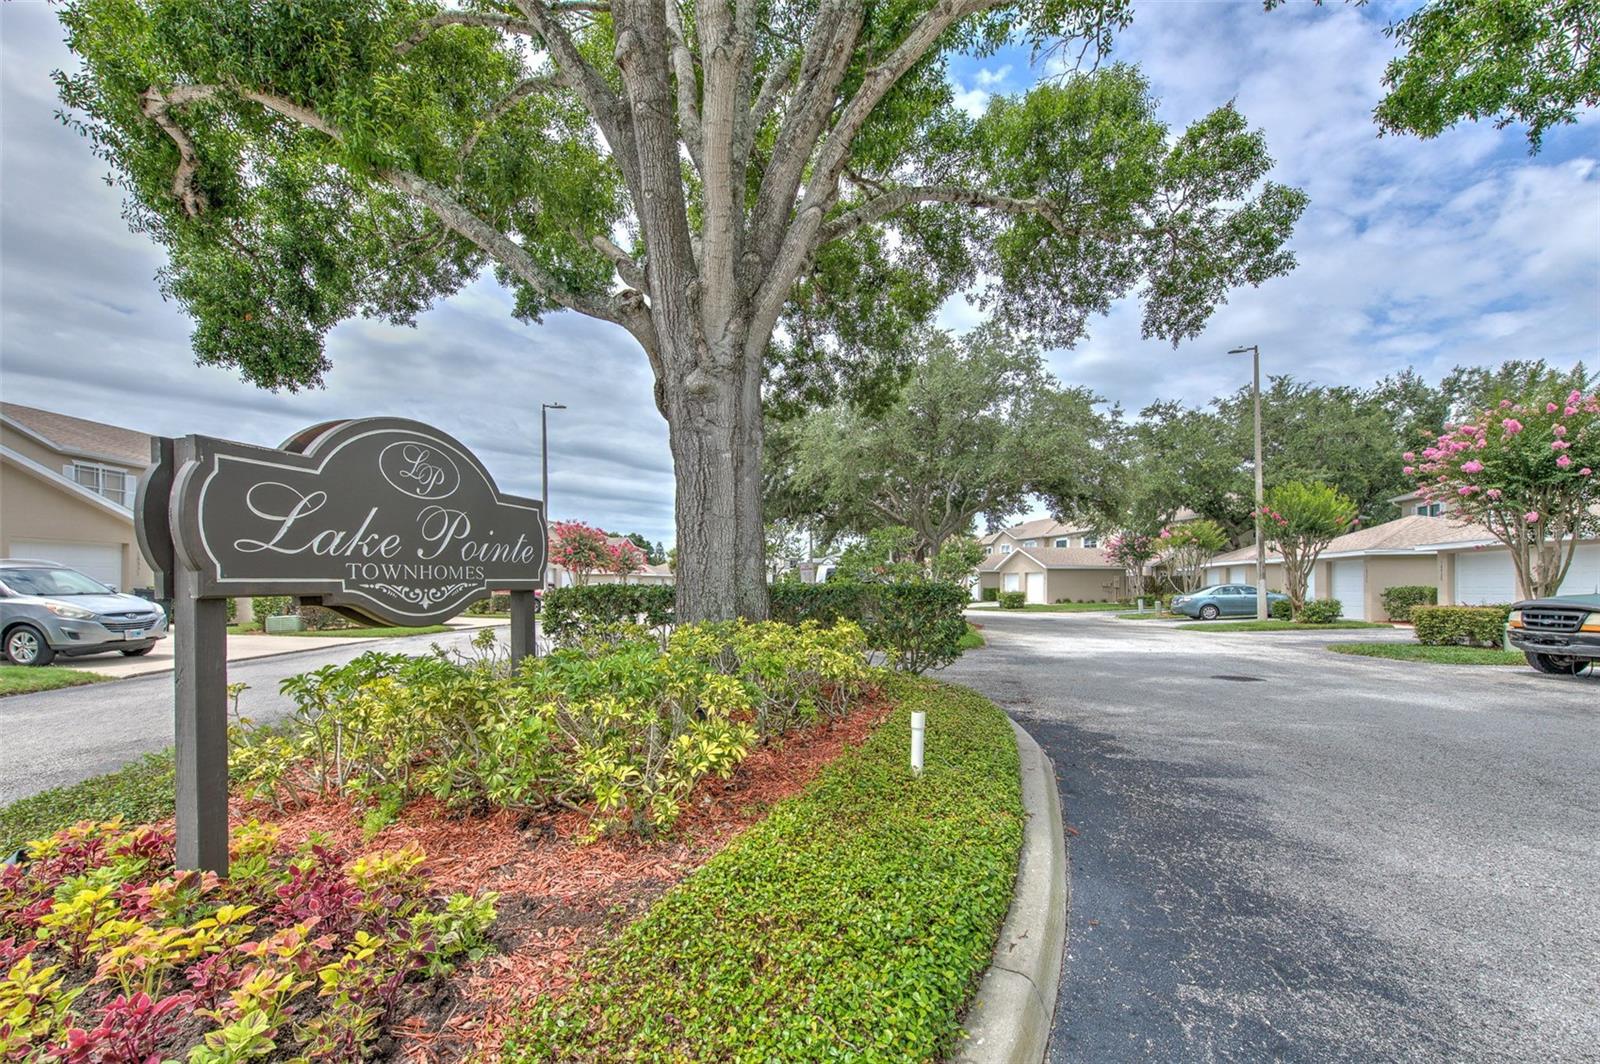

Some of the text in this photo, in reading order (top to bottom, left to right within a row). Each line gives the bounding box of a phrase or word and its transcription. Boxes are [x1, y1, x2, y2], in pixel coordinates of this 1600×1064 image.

[233, 481, 535, 565] Lake Pointe
[345, 562, 485, 581] TOWNHOMES
